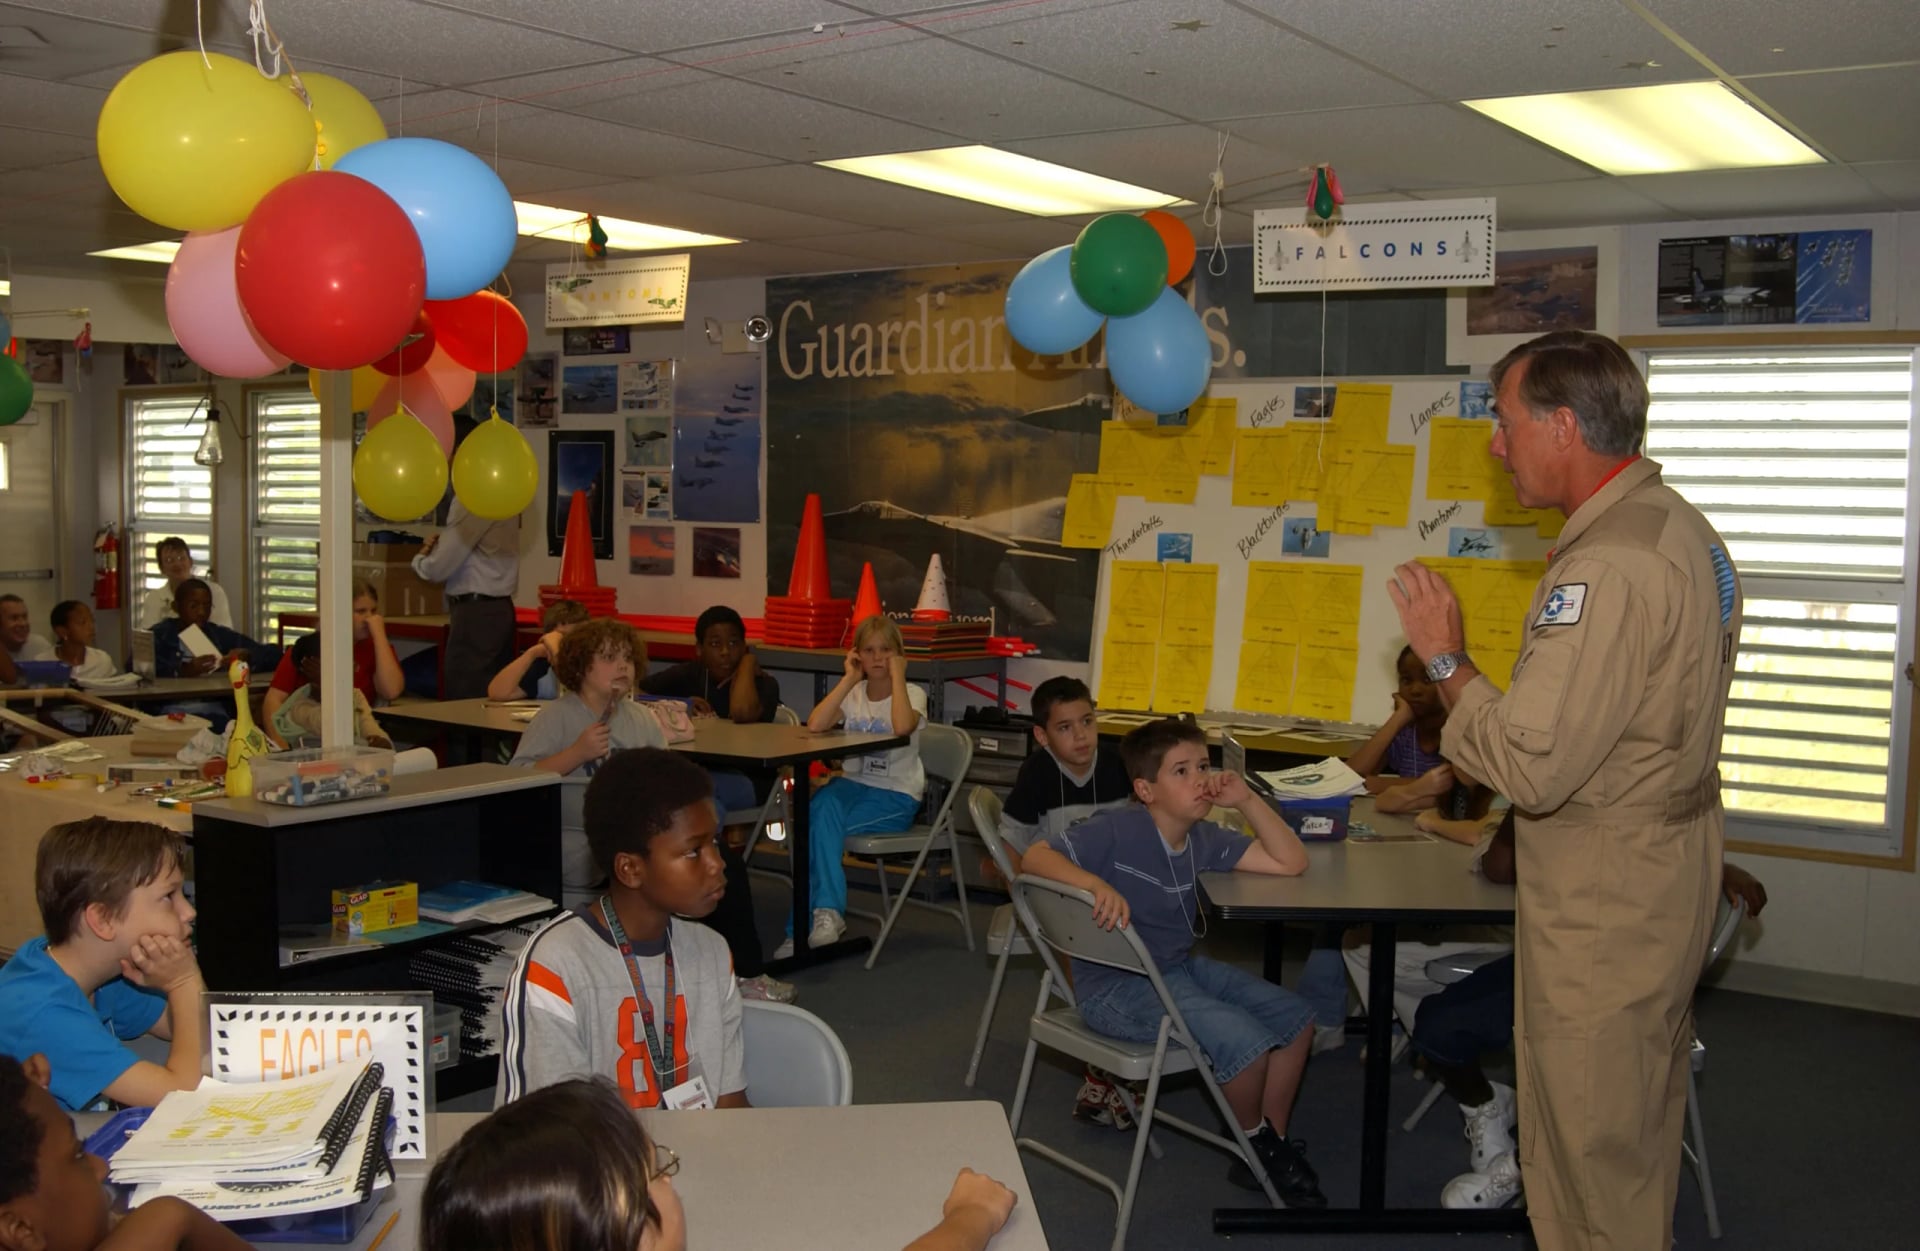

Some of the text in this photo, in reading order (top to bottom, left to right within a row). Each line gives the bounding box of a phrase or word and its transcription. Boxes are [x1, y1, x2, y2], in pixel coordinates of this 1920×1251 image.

[1295, 240, 1447, 260] FALCONS
[778, 291, 1016, 380] Guardian
[350, 892, 368, 904] GLAD
